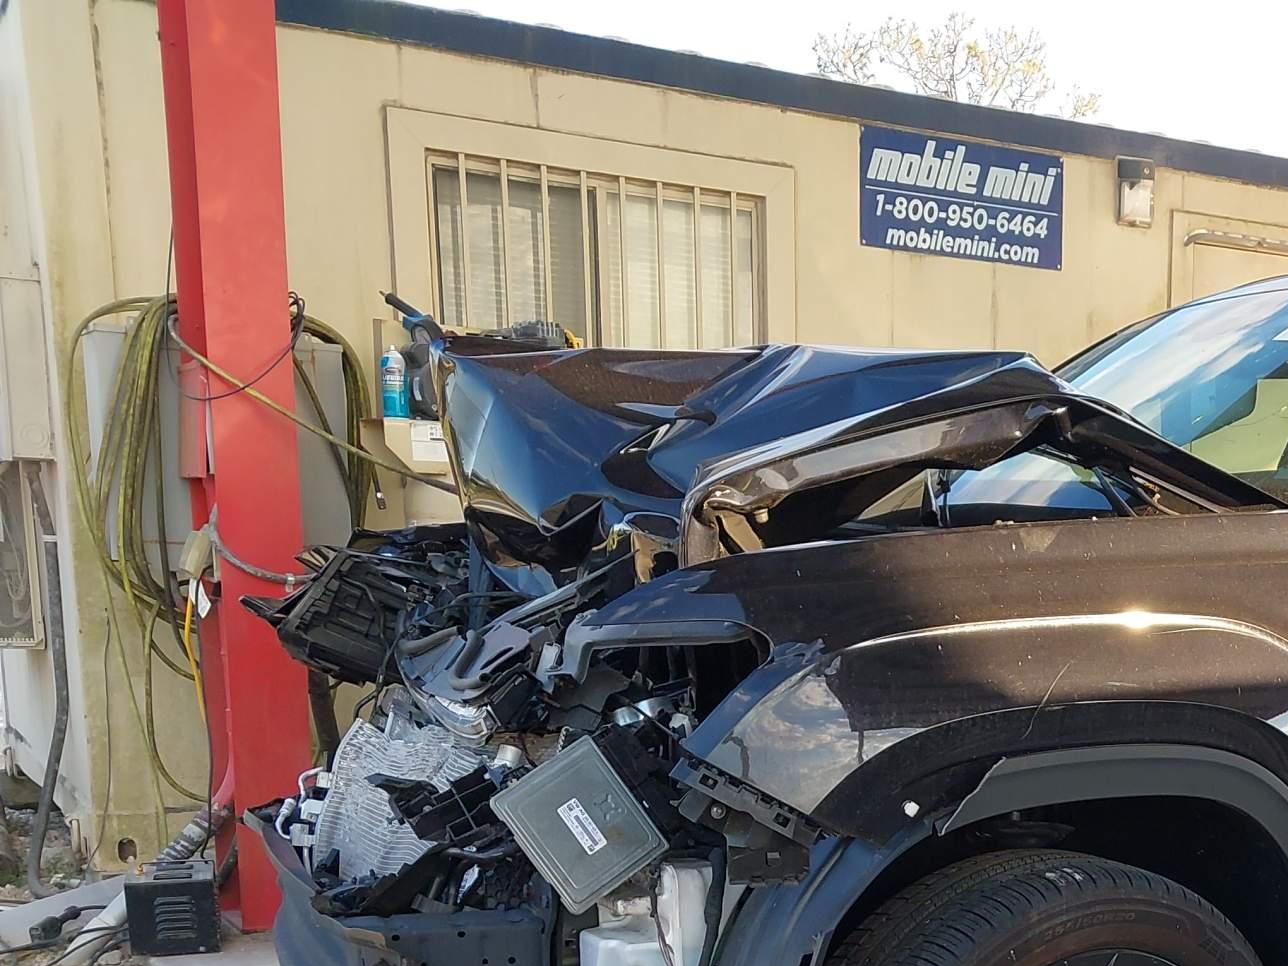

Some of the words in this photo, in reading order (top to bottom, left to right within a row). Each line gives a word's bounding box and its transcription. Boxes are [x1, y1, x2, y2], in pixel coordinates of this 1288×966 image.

[866, 140, 981, 194] mobile
[983, 162, 1057, 205] mini
[876, 194, 1048, 239] 1-800-950-6464
[885, 227, 1040, 263] mobilemini.com
